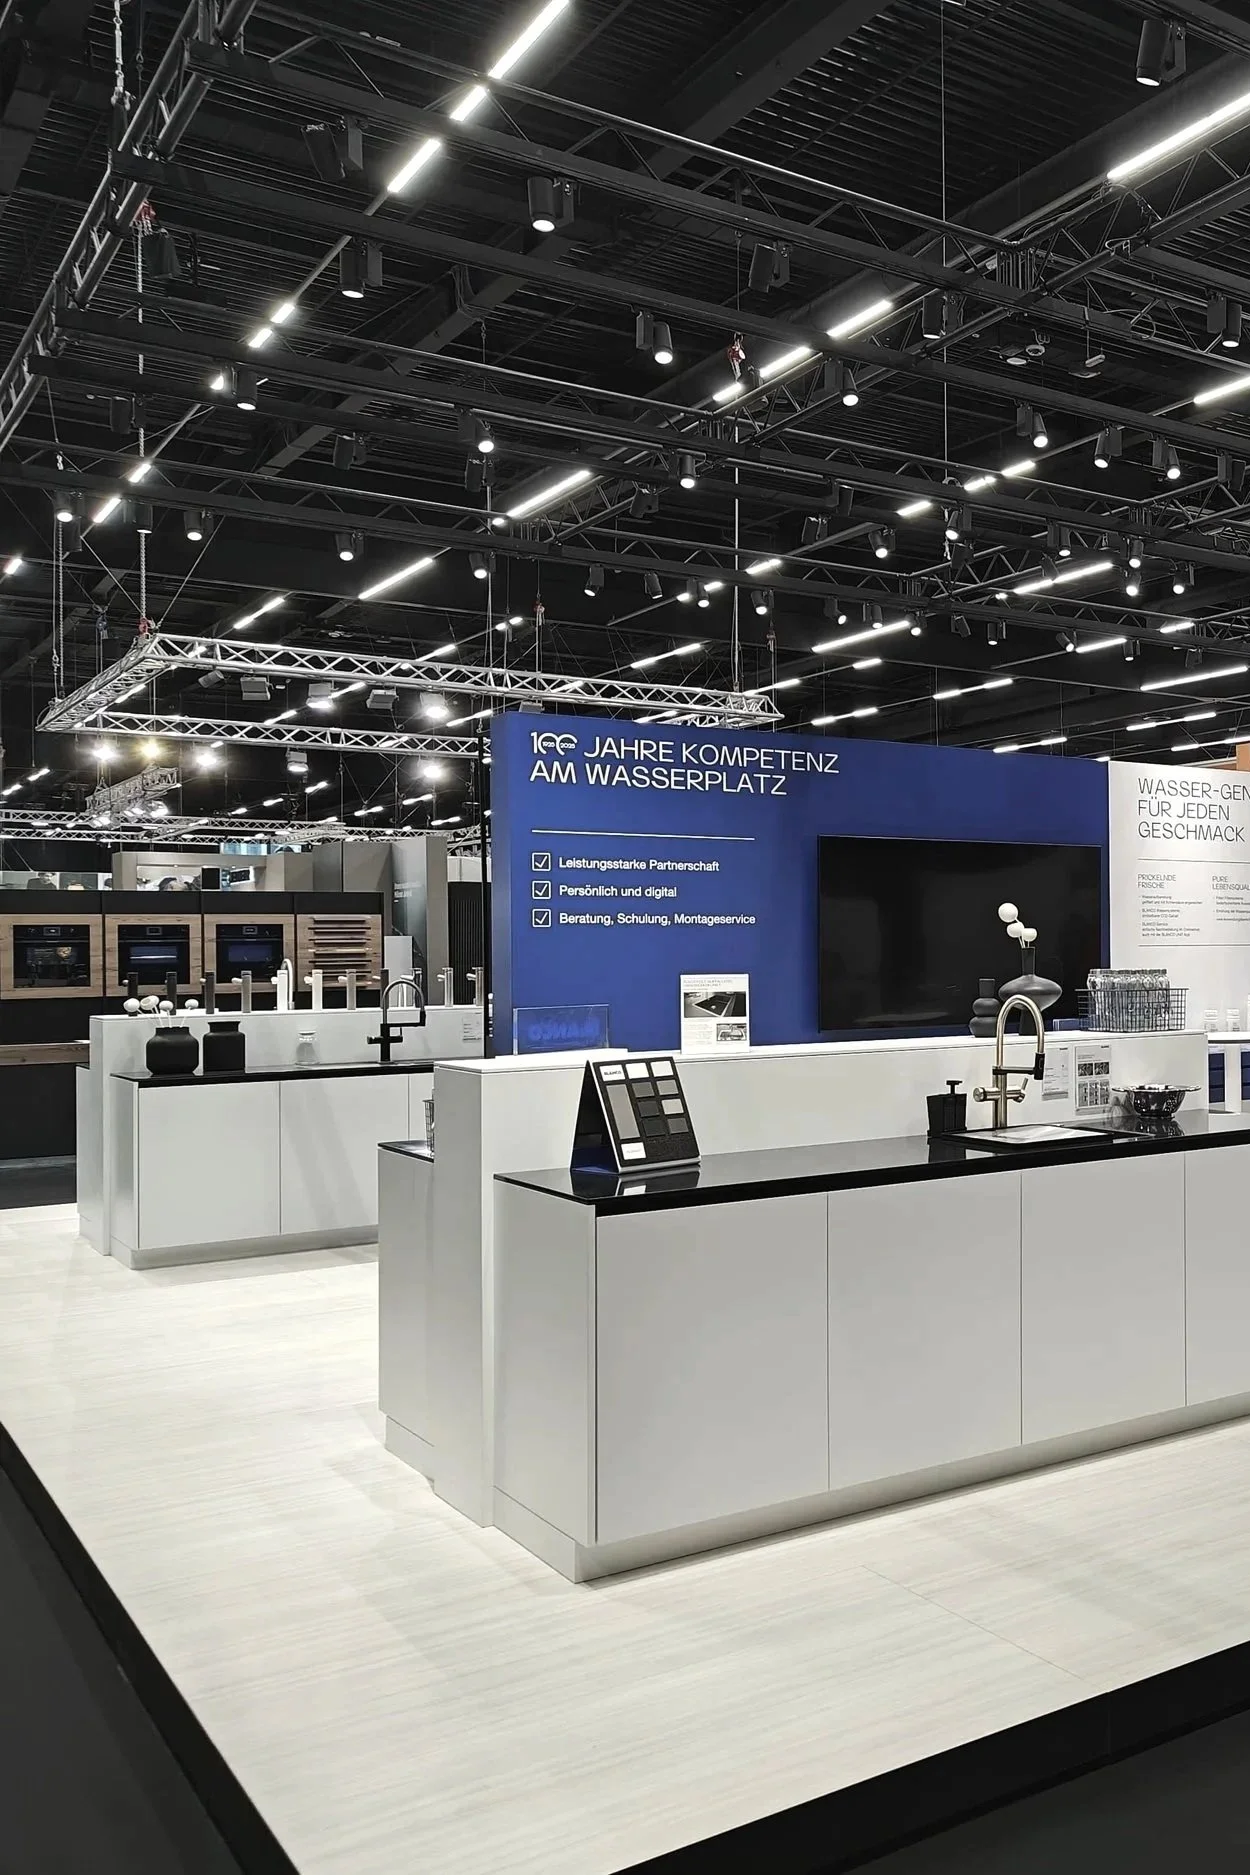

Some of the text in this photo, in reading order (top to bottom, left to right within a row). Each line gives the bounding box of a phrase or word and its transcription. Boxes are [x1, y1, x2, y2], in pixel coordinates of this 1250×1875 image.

[583, 736, 675, 763] JAHRE
[682, 742, 840, 774] KOMPETENZ
[529, 759, 787, 796] AM WASSERPLATZ
[1138, 796, 1230, 821] FÜR JEDEN
[1138, 820, 1246, 843] GESCHMACK
[558, 856, 720, 872] Leistungsstarke Partnerschaft
[1137, 874, 1177, 882] PRICKELNDE
[1137, 881, 1165, 889] FRISCHE
[559, 884, 677, 899] Persönlich und digital
[559, 912, 756, 927] Beratung, Schulung, Montageservice
